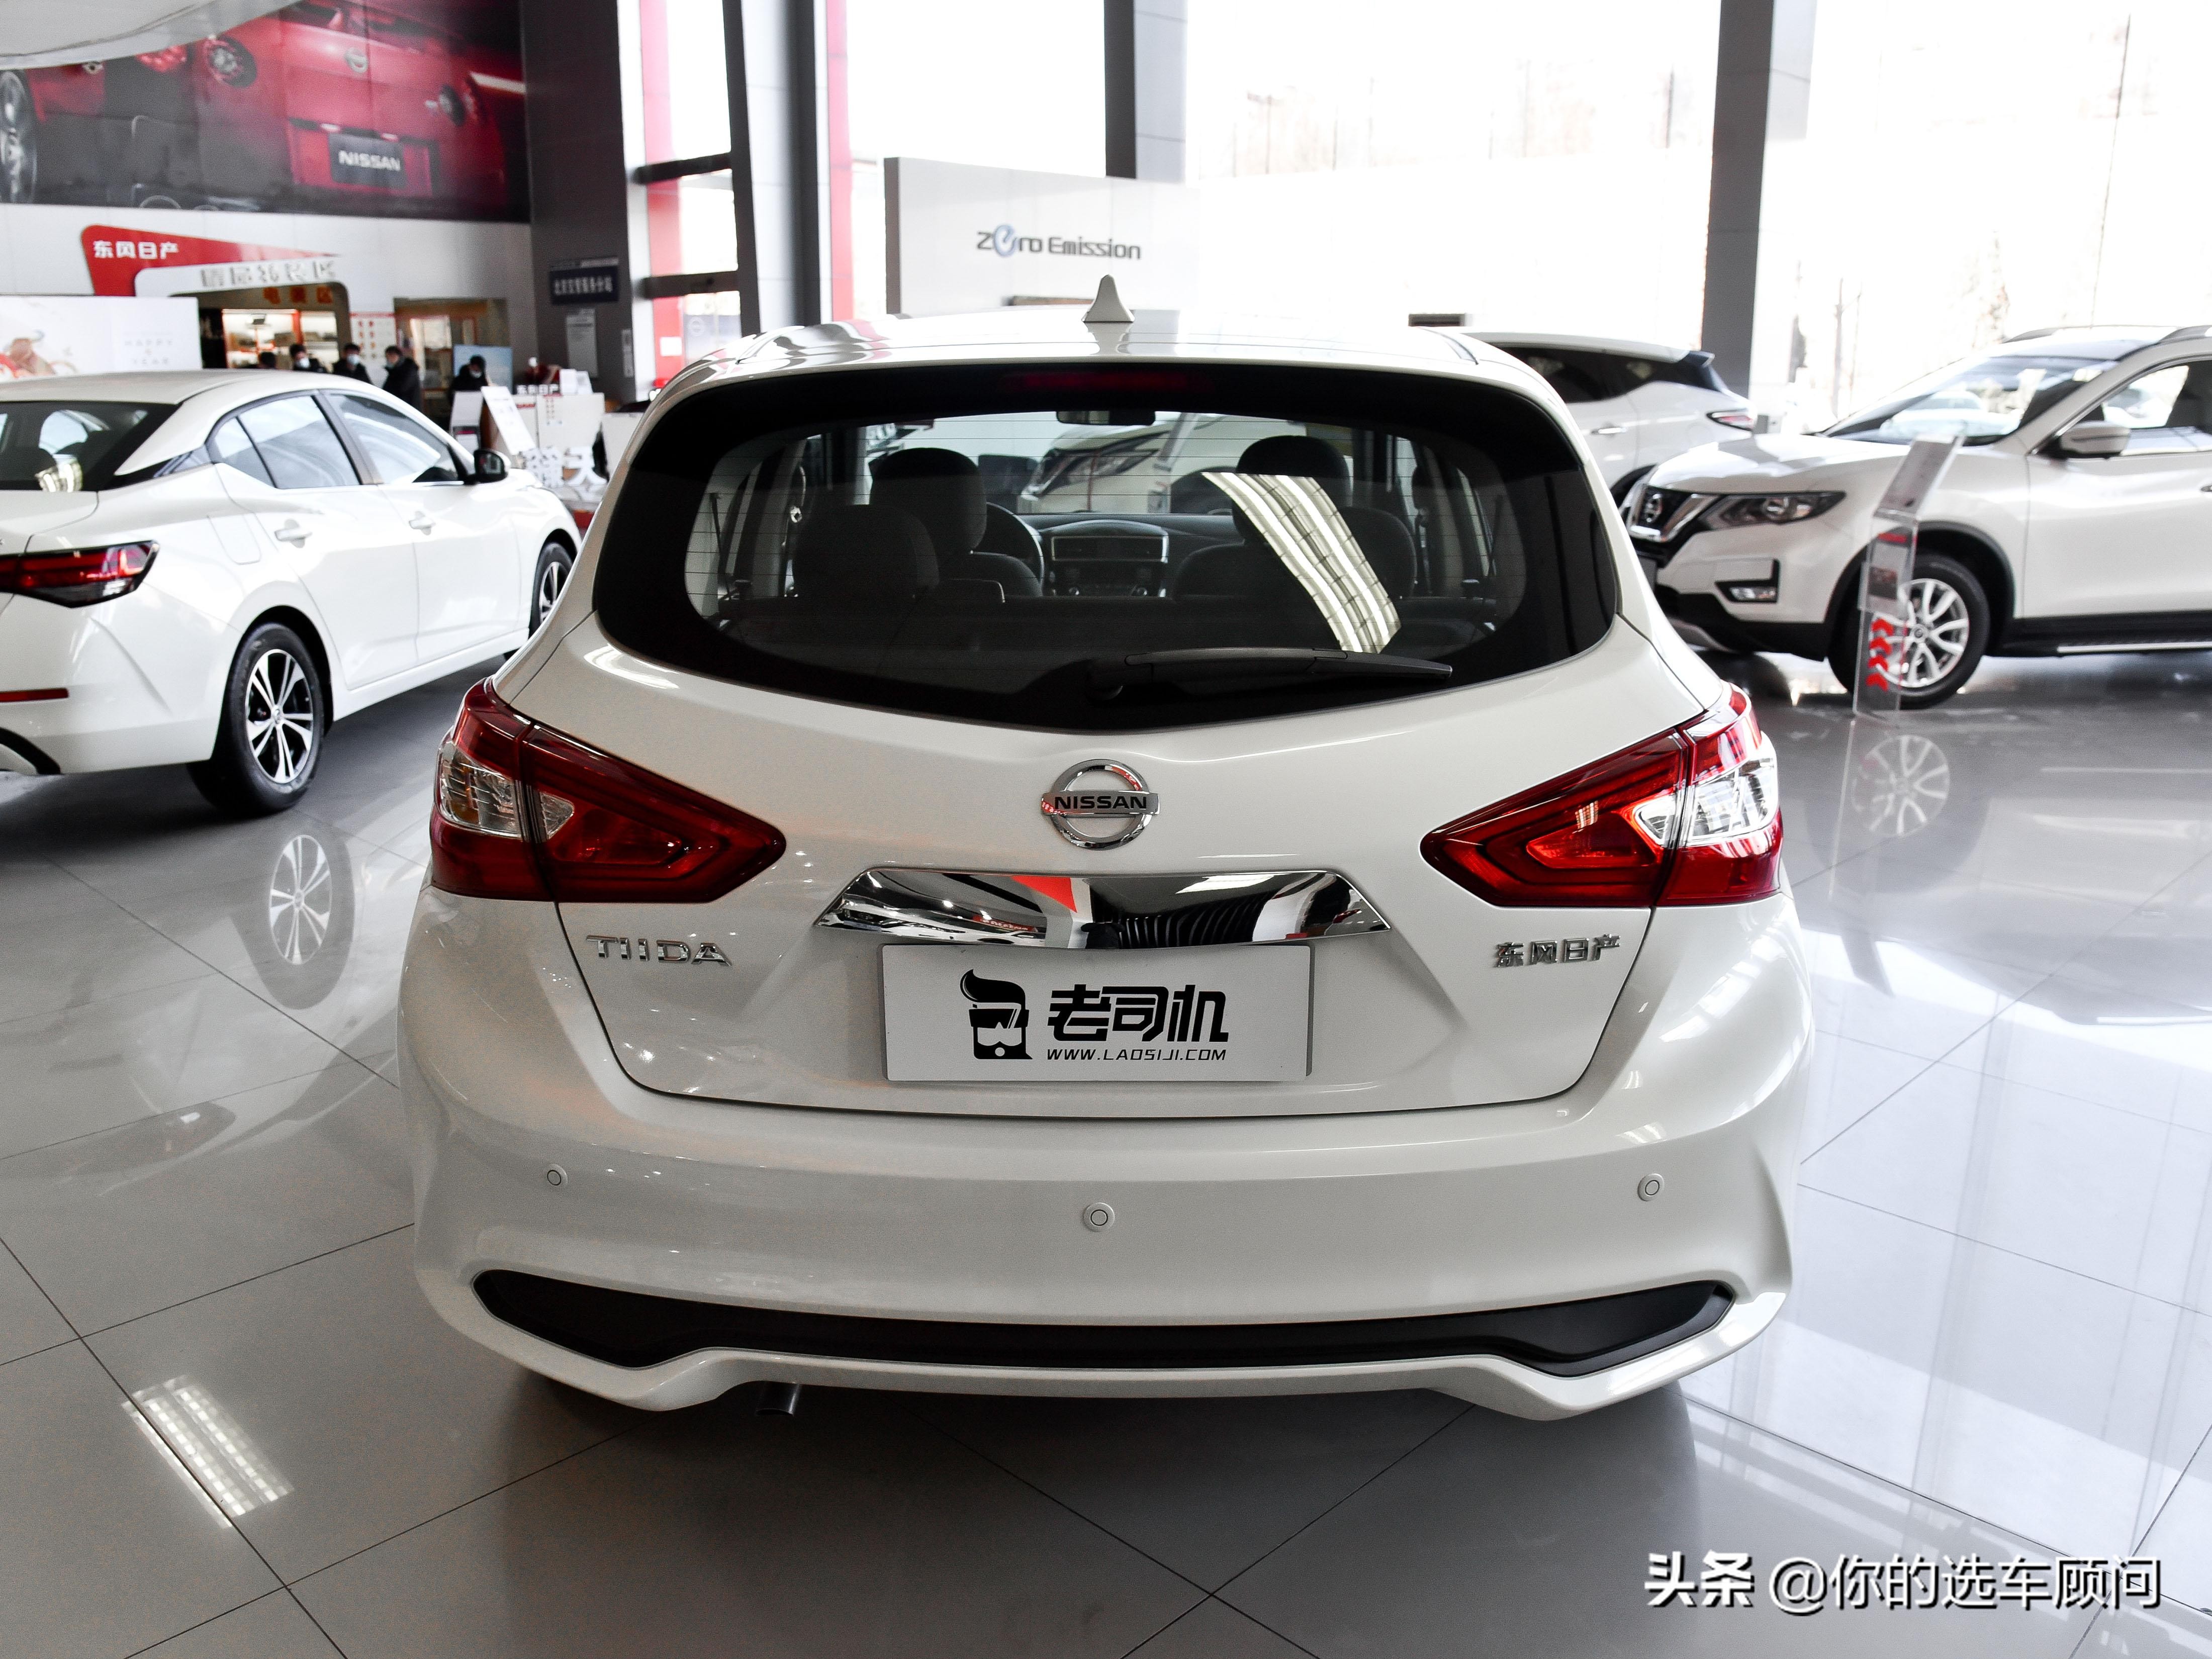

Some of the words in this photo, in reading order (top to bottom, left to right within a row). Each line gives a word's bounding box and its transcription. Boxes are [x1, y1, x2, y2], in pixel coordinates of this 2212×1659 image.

[338, 150, 401, 171] NISSAN
[93, 240, 179, 260] 东风日产
[1049, 236, 1141, 259] Emission
[1054, 795, 1147, 809] NISSAN
[586, 935, 732, 966] TIIDA
[1492, 933, 1621, 968] 东风日产
[1047, 983, 1229, 1042] 老司机
[1047, 1049, 1227, 1061] WWW.LAOSIJI.COM
